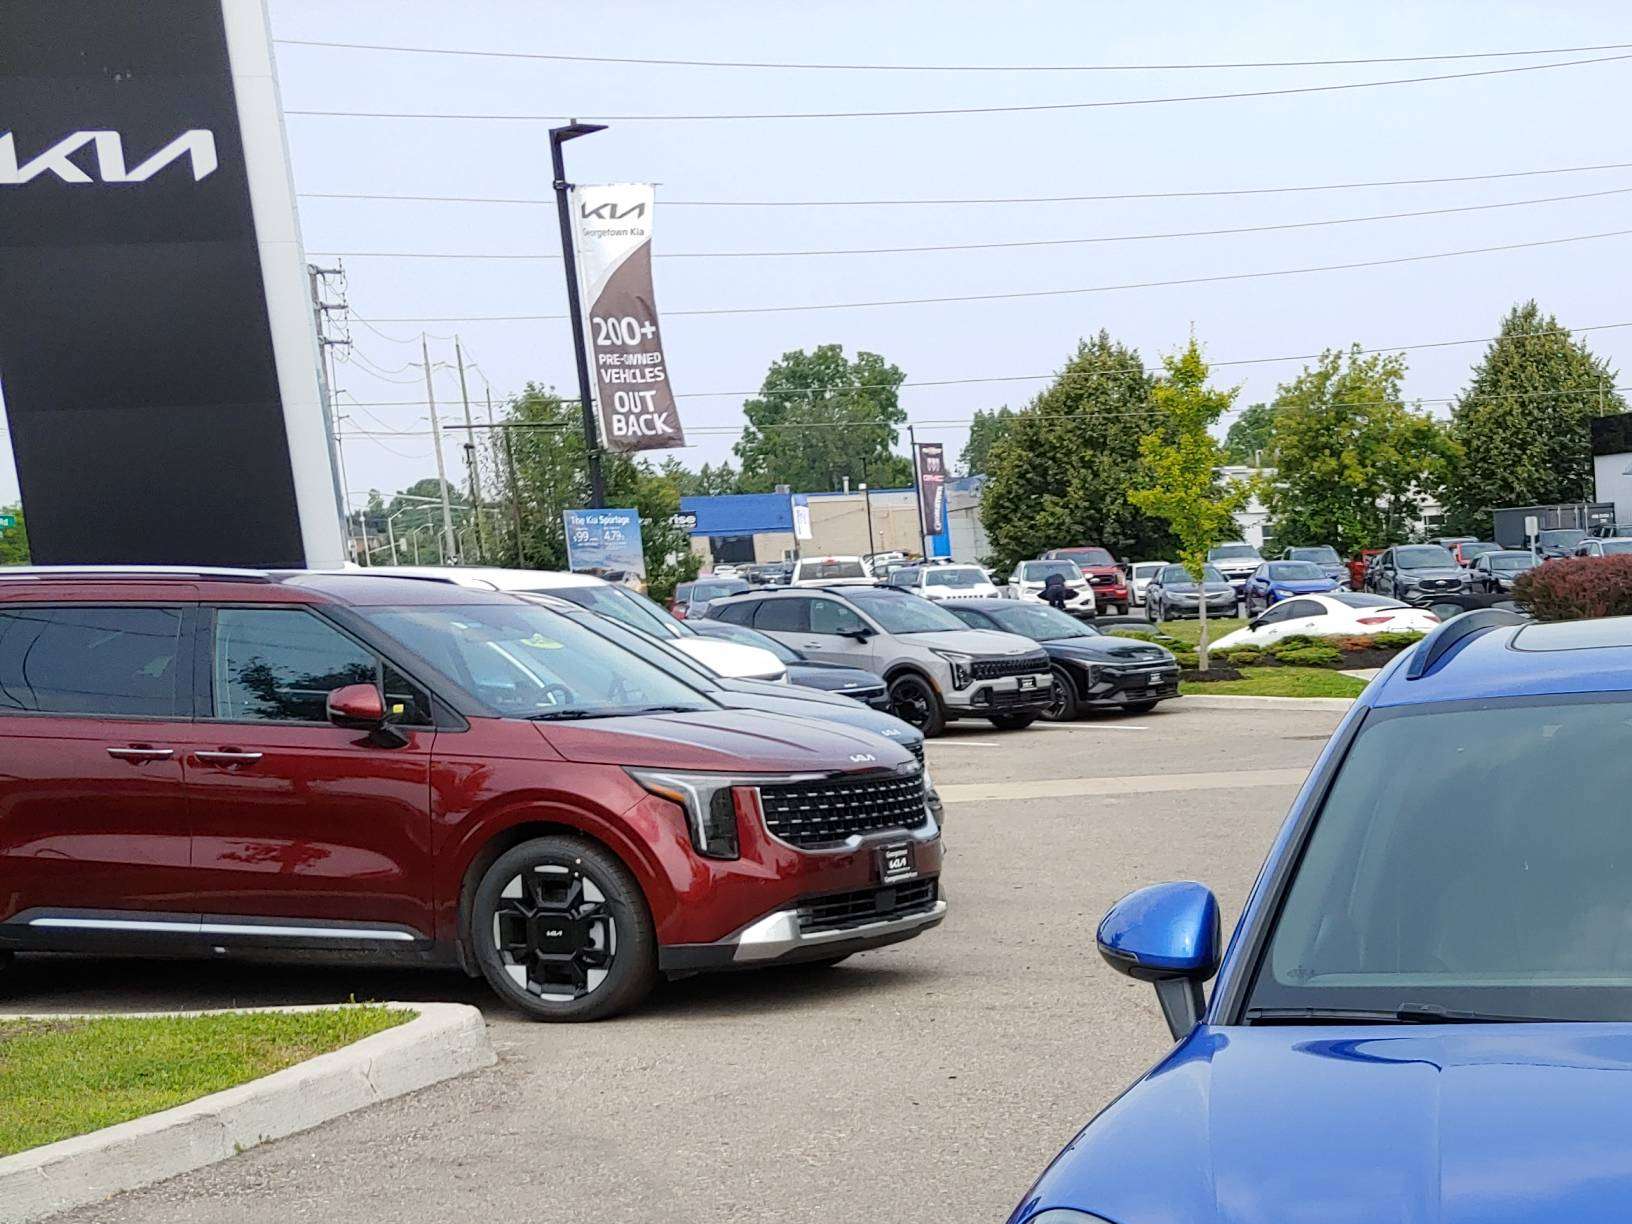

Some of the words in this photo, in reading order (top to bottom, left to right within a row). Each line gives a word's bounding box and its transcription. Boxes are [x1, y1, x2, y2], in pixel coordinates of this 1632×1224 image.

[0, 129, 218, 184] KIA
[581, 202, 645, 219] KIA
[630, 228, 645, 236] Kia
[593, 317, 656, 346] 200+
[614, 390, 656, 413] OUT
[612, 412, 673, 436] BACK
